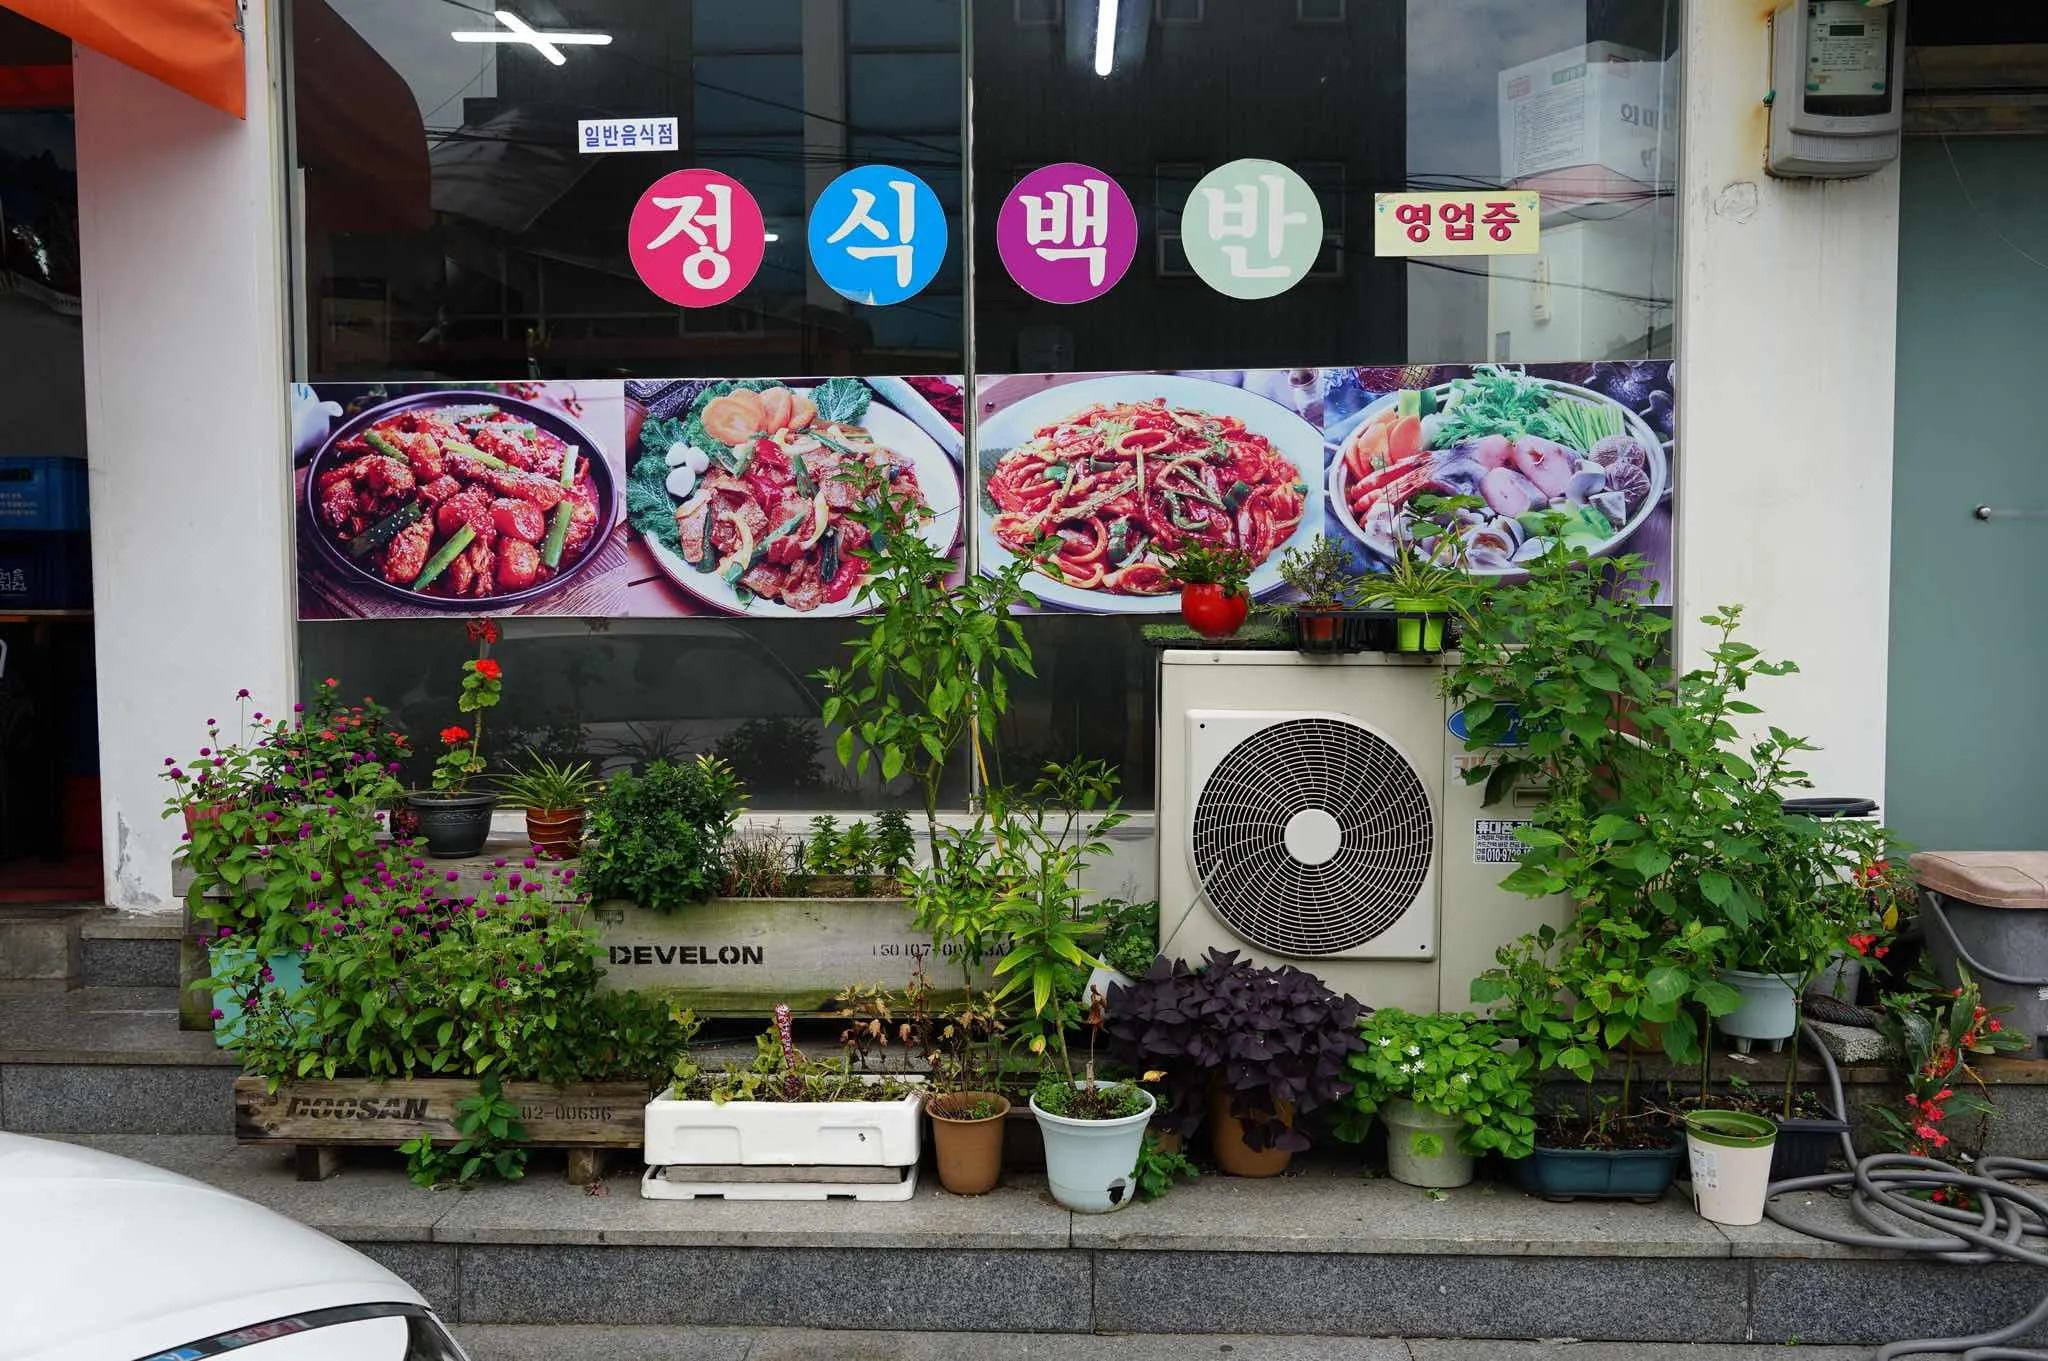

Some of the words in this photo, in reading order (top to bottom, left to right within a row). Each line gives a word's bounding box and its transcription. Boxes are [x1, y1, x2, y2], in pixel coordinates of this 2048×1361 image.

[585, 123, 672, 147] 일반음식점
[1395, 203, 1520, 243] 영업중
[609, 946, 763, 965] DEVELON
[286, 1096, 430, 1120] DOOSAN
